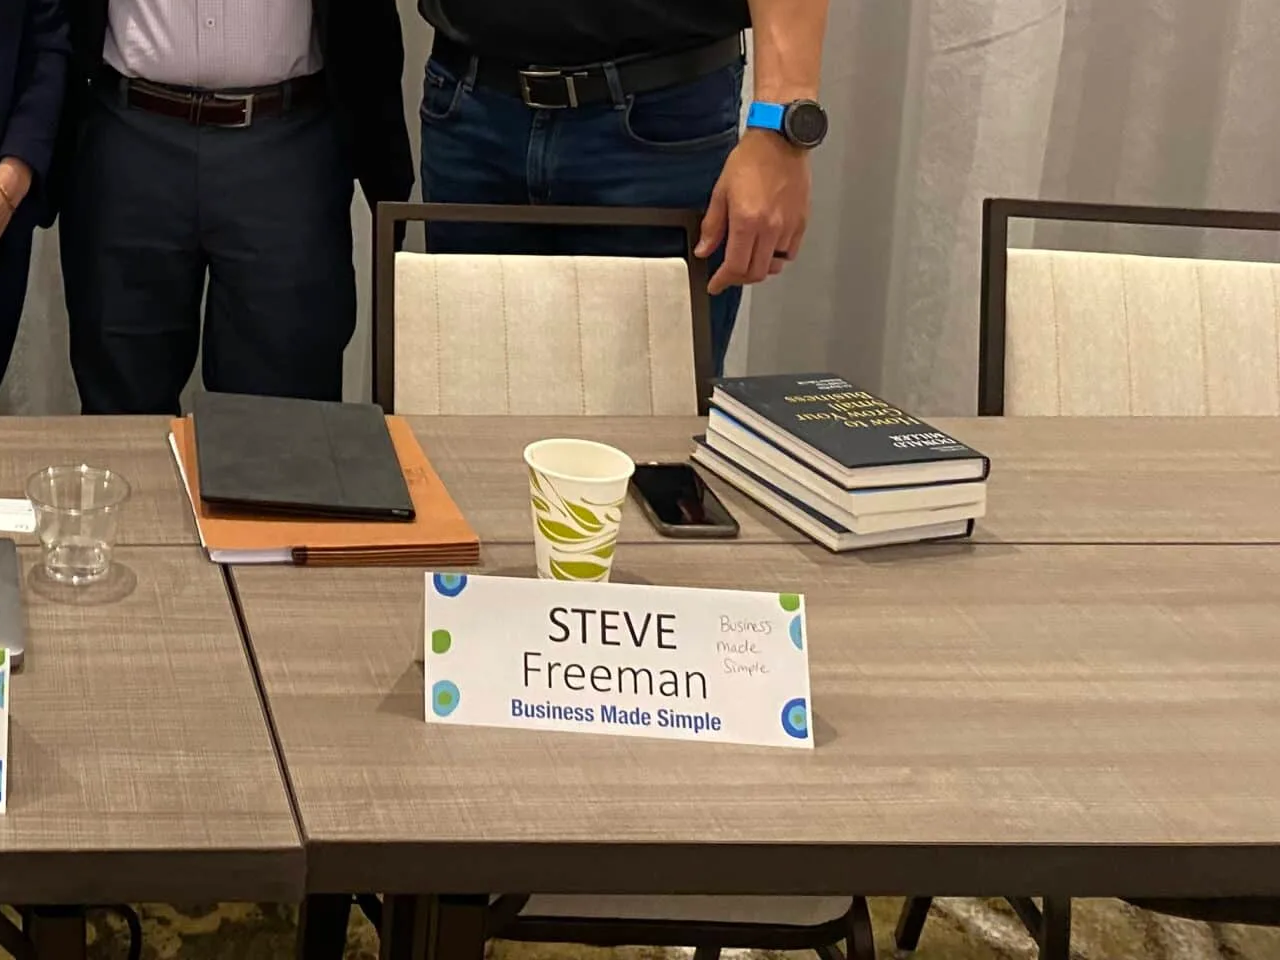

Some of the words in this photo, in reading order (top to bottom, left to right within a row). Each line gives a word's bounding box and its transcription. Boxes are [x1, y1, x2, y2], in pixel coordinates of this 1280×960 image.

[784, 392, 873, 403] Business
[828, 400, 889, 411] Small
[796, 412, 847, 421] Your
[847, 408, 903, 419] Grow
[844, 420, 869, 428] to
[871, 416, 921, 427] How
[548, 606, 678, 650] STEVE
[720, 615, 772, 635] Business
[723, 658, 770, 677] Simple
[522, 652, 708, 700] Freeman
[510, 698, 595, 723] Business
[600, 705, 652, 728] Made
[656, 712, 722, 734] Simple
